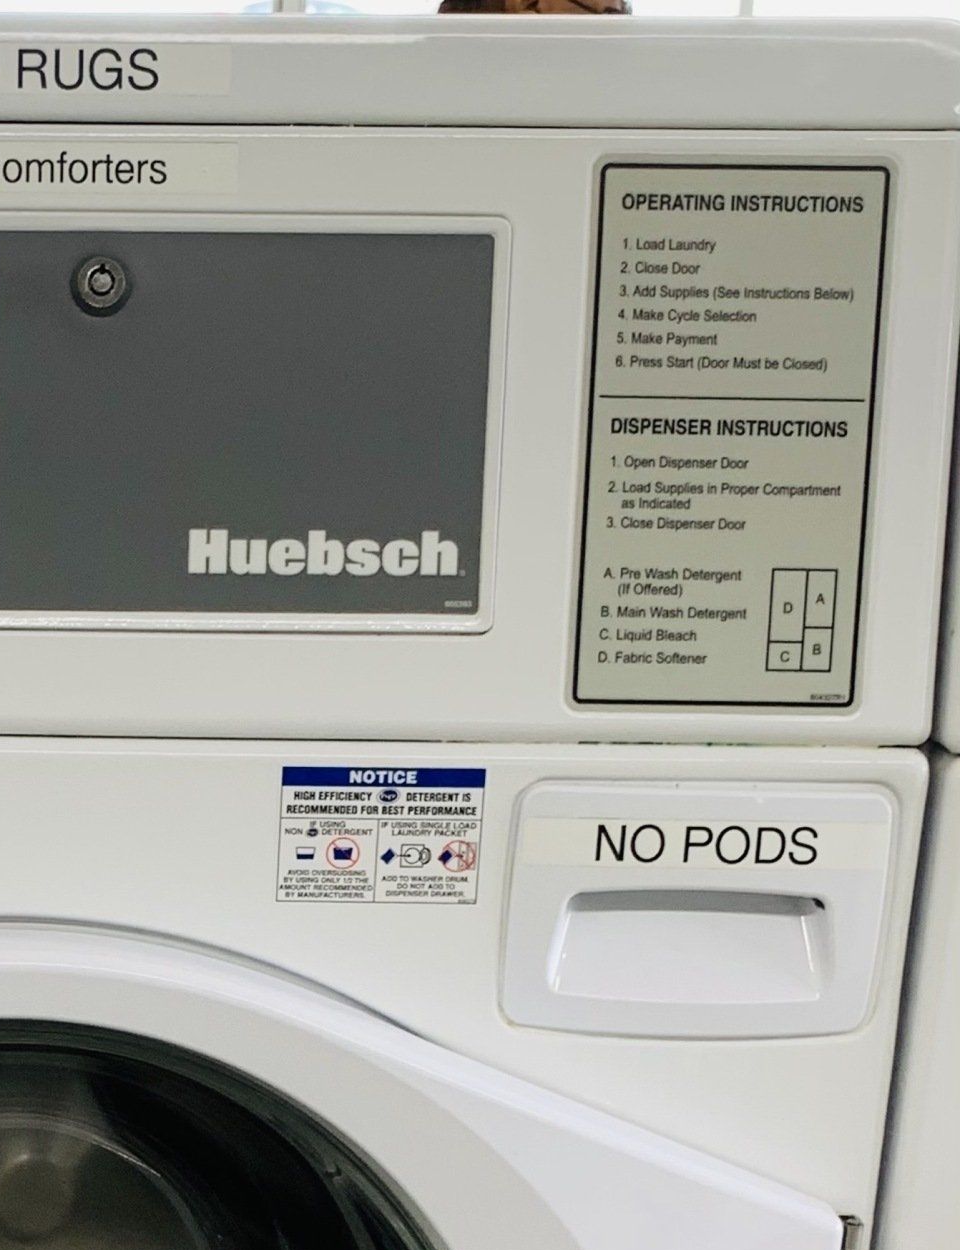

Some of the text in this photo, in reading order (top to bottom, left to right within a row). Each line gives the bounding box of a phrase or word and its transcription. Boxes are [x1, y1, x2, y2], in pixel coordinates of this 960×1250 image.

[17, 48, 159, 91] RUGS
[622, 194, 864, 213] OPERATING INSTRUCTIONS
[623, 238, 716, 253] 1. Load Laundry
[620, 261, 700, 274] 2. Close Door
[619, 285, 854, 302] 3. Add Supplies (See Instructions Below)
[618, 309, 757, 324] 4. Make Cycle Selection
[617, 332, 717, 348] 5. Make Payment
[616, 356, 828, 371] 6. Press Start (Door Must be Closed)
[611, 418, 848, 437] DISPENSER INSTRUCTIONS
[611, 456, 749, 470] 1. Open Dispenser Door
[608, 481, 841, 498] 2. Load Supplies in Proper Compartment
[621, 498, 690, 509] as Indicated
[607, 517, 746, 531] 3. Close Dispenser Door
[188, 529, 459, 576] Huebsch
[604, 568, 741, 583] A. Pre Wash Detergent
[618, 583, 683, 597] (If Offered)
[816, 594, 825, 604] A
[601, 606, 747, 621] B. Main Wash Detergent
[783, 603, 793, 613] D
[599, 629, 696, 643] C. Liquid Bleach
[812, 644, 821, 655] B
[598, 652, 707, 664] D. Fabric Softener
[780, 652, 790, 662] C
[349, 770, 417, 784] NOTICE
[294, 791, 315, 800] HIGH
[319, 792, 372, 801] EFFICIENCY
[406, 793, 459, 801] DETERGENT
[462, 793, 471, 802] IS
[286, 805, 477, 816] RECOMMENDED FOR BEST PERFORMANCE
[594, 824, 818, 865] NO PODS
